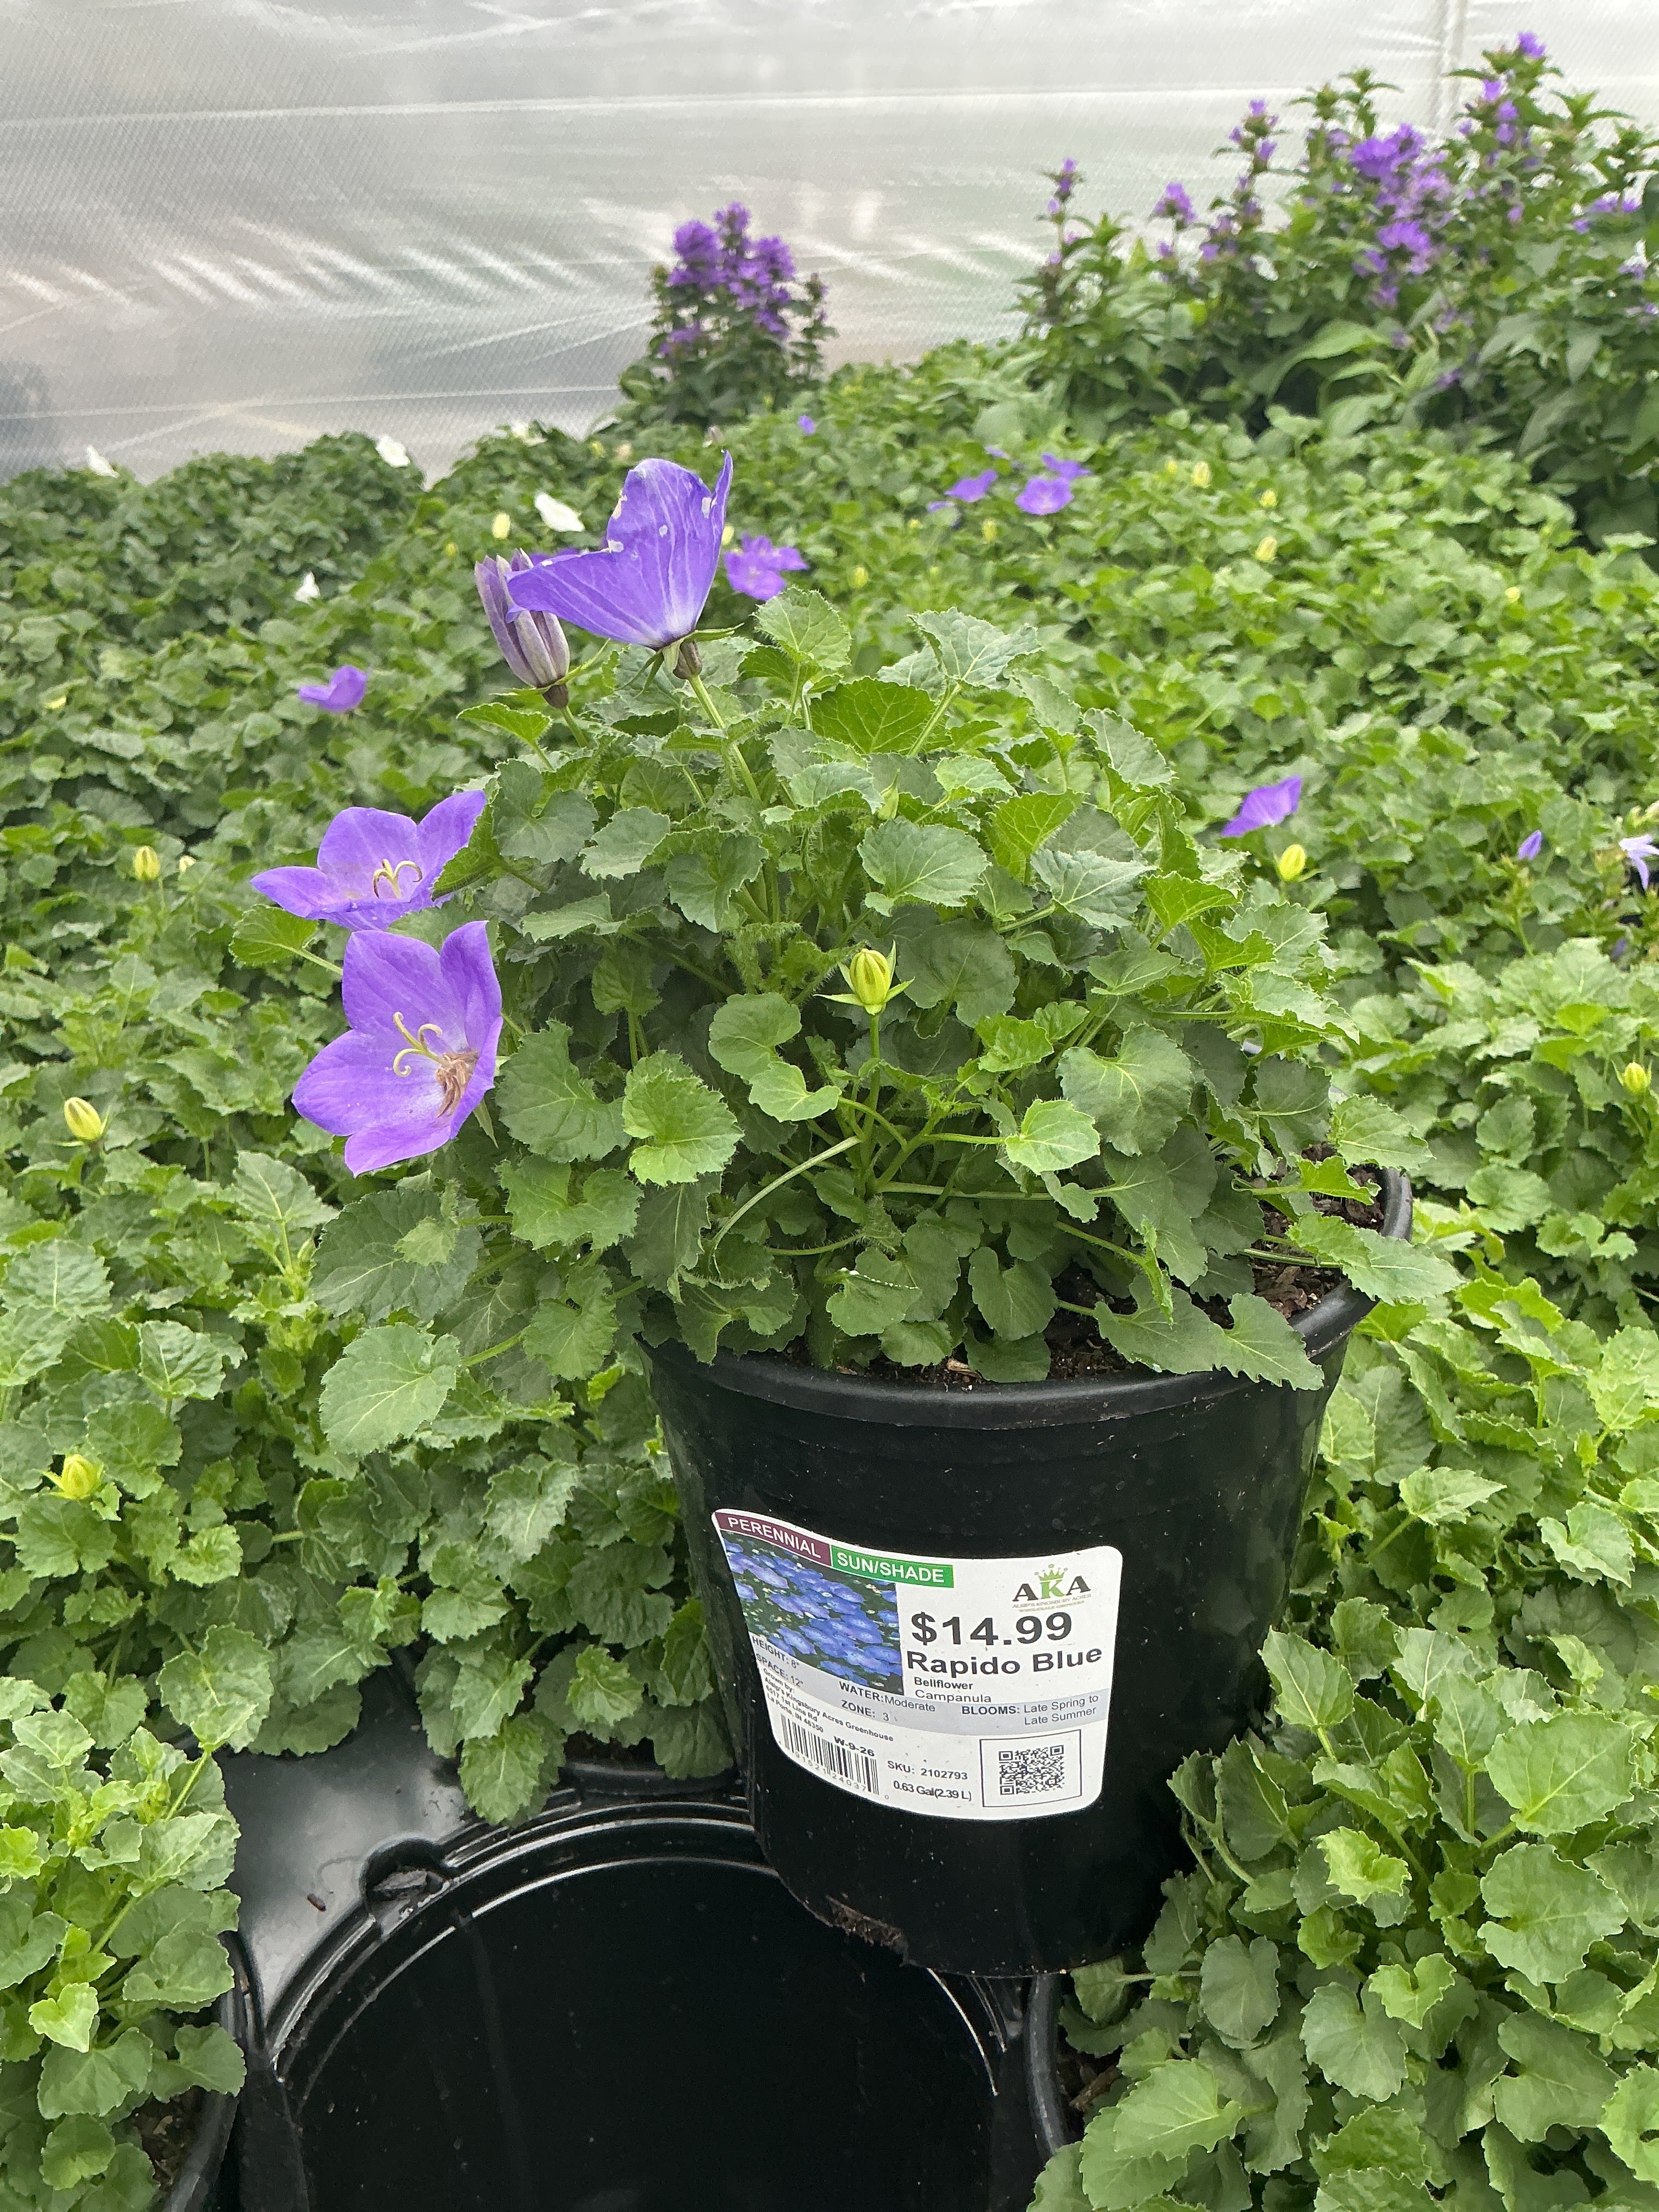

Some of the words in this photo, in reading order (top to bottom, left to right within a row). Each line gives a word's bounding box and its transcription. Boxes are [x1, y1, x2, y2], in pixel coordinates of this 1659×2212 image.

[727, 1517, 821, 1559] PERENNIAL
[837, 1553, 945, 1583] SUN/SHADE
[1012, 1575, 1091, 1601] AKA
[911, 1612, 1072, 1645] $14.99
[752, 1636, 789, 1664] HEIGHT:
[756, 1653, 789, 1680] SPACE:
[907, 1651, 1020, 1678] Rapido
[1033, 1648, 1102, 1672] Blue
[764, 1668, 783, 1686] Grown
[914, 1677, 973, 1690] Bellflower
[839, 1681, 884, 1702] WATER:
[885, 1695, 935, 1712] Moderate
[915, 1689, 991, 1703] Campanula
[962, 1705, 1020, 1715] BLOOMS:
[1024, 1704, 1048, 1713] Late
[1052, 1697, 1085, 1711] Spring
[1089, 1695, 1099, 1703] to
[786, 1692, 820, 1716] Kingsbury
[822, 1712, 843, 1725] Acres
[845, 1722, 894, 1741] Greenhouse
[792, 1703, 806, 1716] Line
[808, 1712, 817, 1722] Rd
[841, 1700, 875, 1718] ZONE:
[883, 1712, 889, 1721] 3
[1024, 1716, 1048, 1725] Late
[1052, 1707, 1097, 1722] Summer
[834, 1735, 875, 1757] W-9-26
[888, 1760, 915, 1774] SKU:
[921, 1768, 968, 1780] 2102793
[893, 1780, 915, 1792] 0.63
